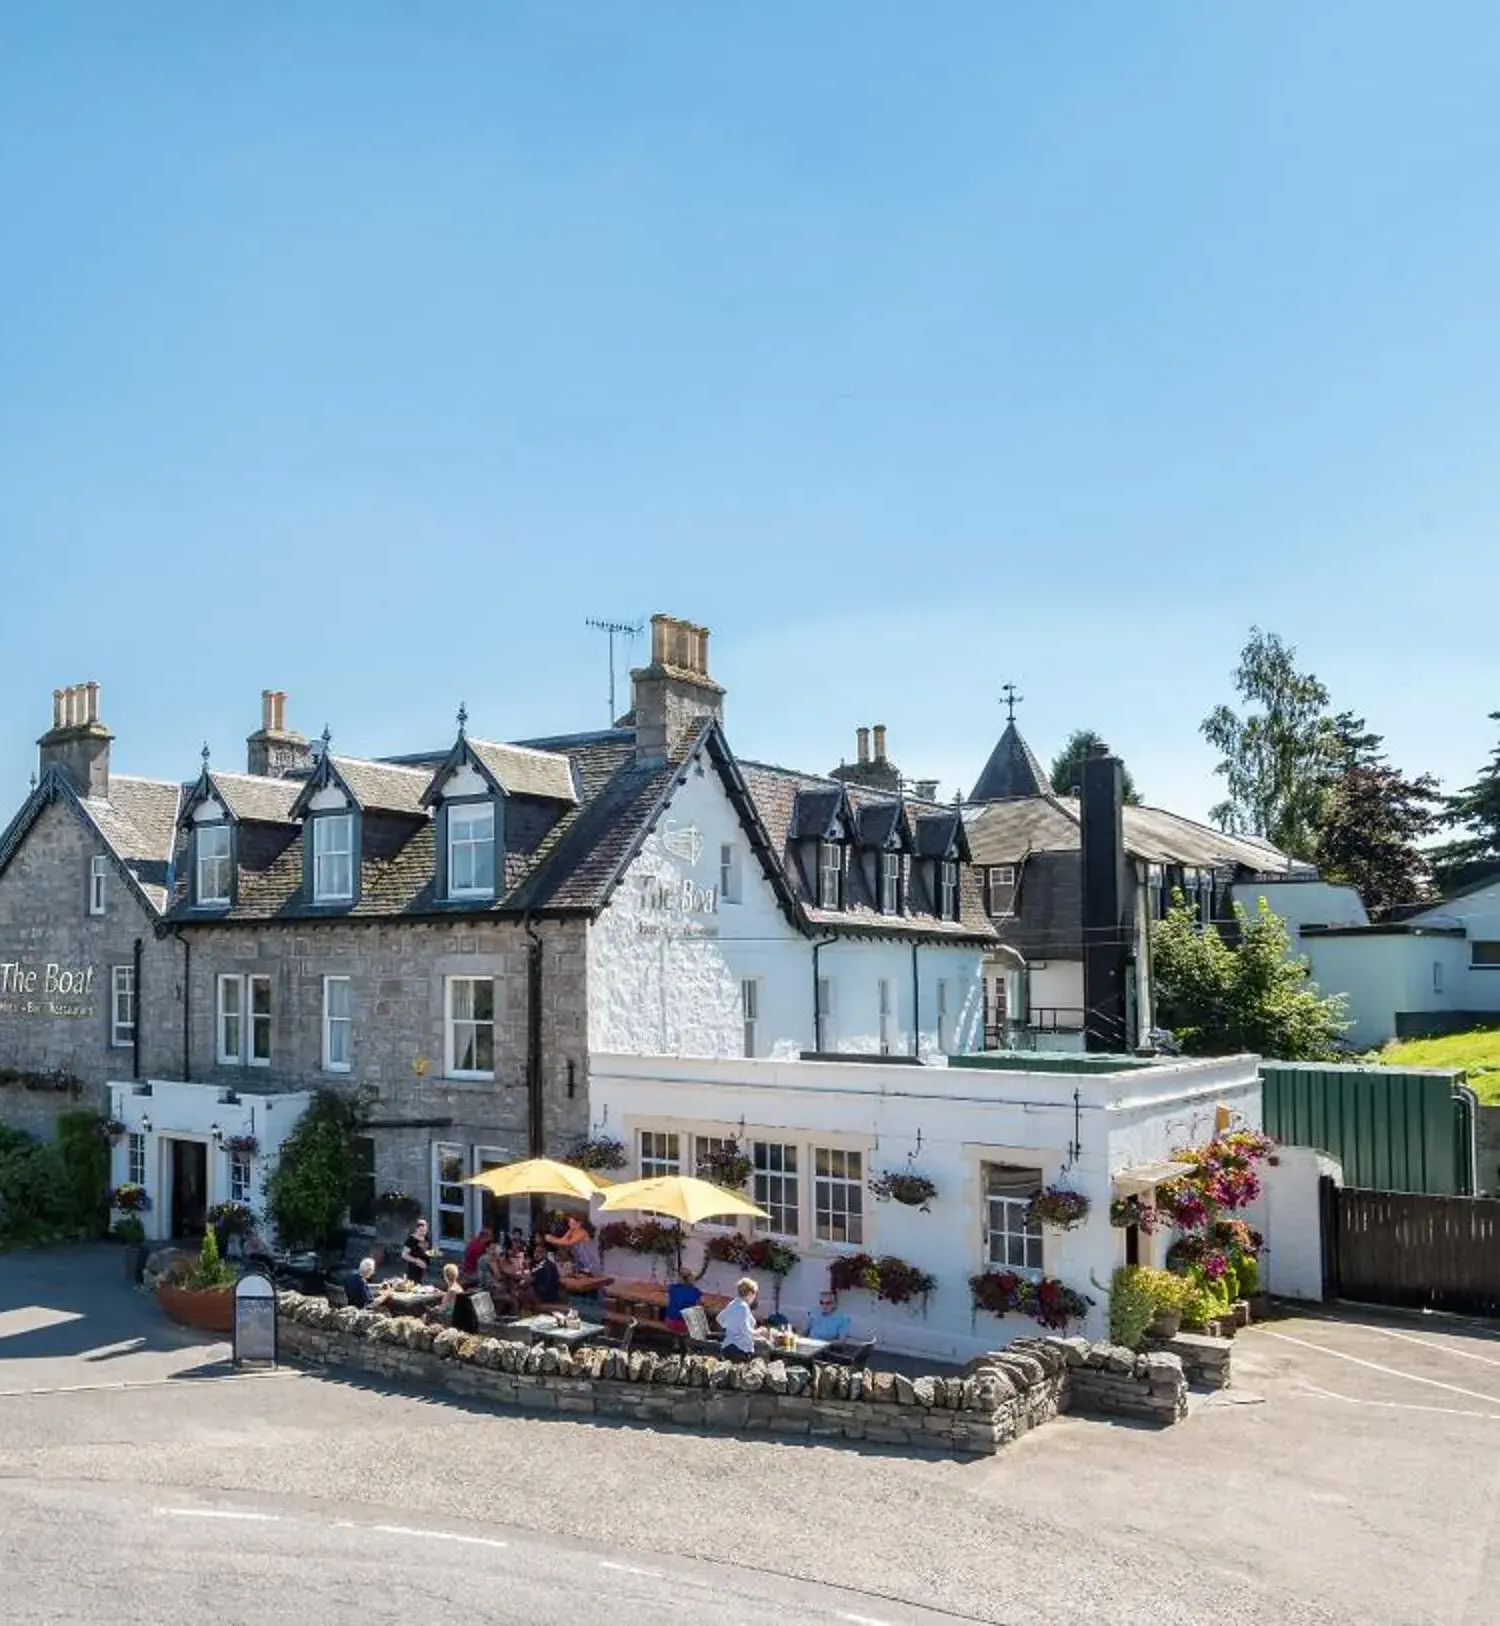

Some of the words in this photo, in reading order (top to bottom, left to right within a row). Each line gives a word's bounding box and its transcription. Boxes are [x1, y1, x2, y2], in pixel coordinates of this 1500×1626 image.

[681, 879, 718, 914] Boat
[0, 961, 37, 992] The
[44, 963, 93, 994] Boat
